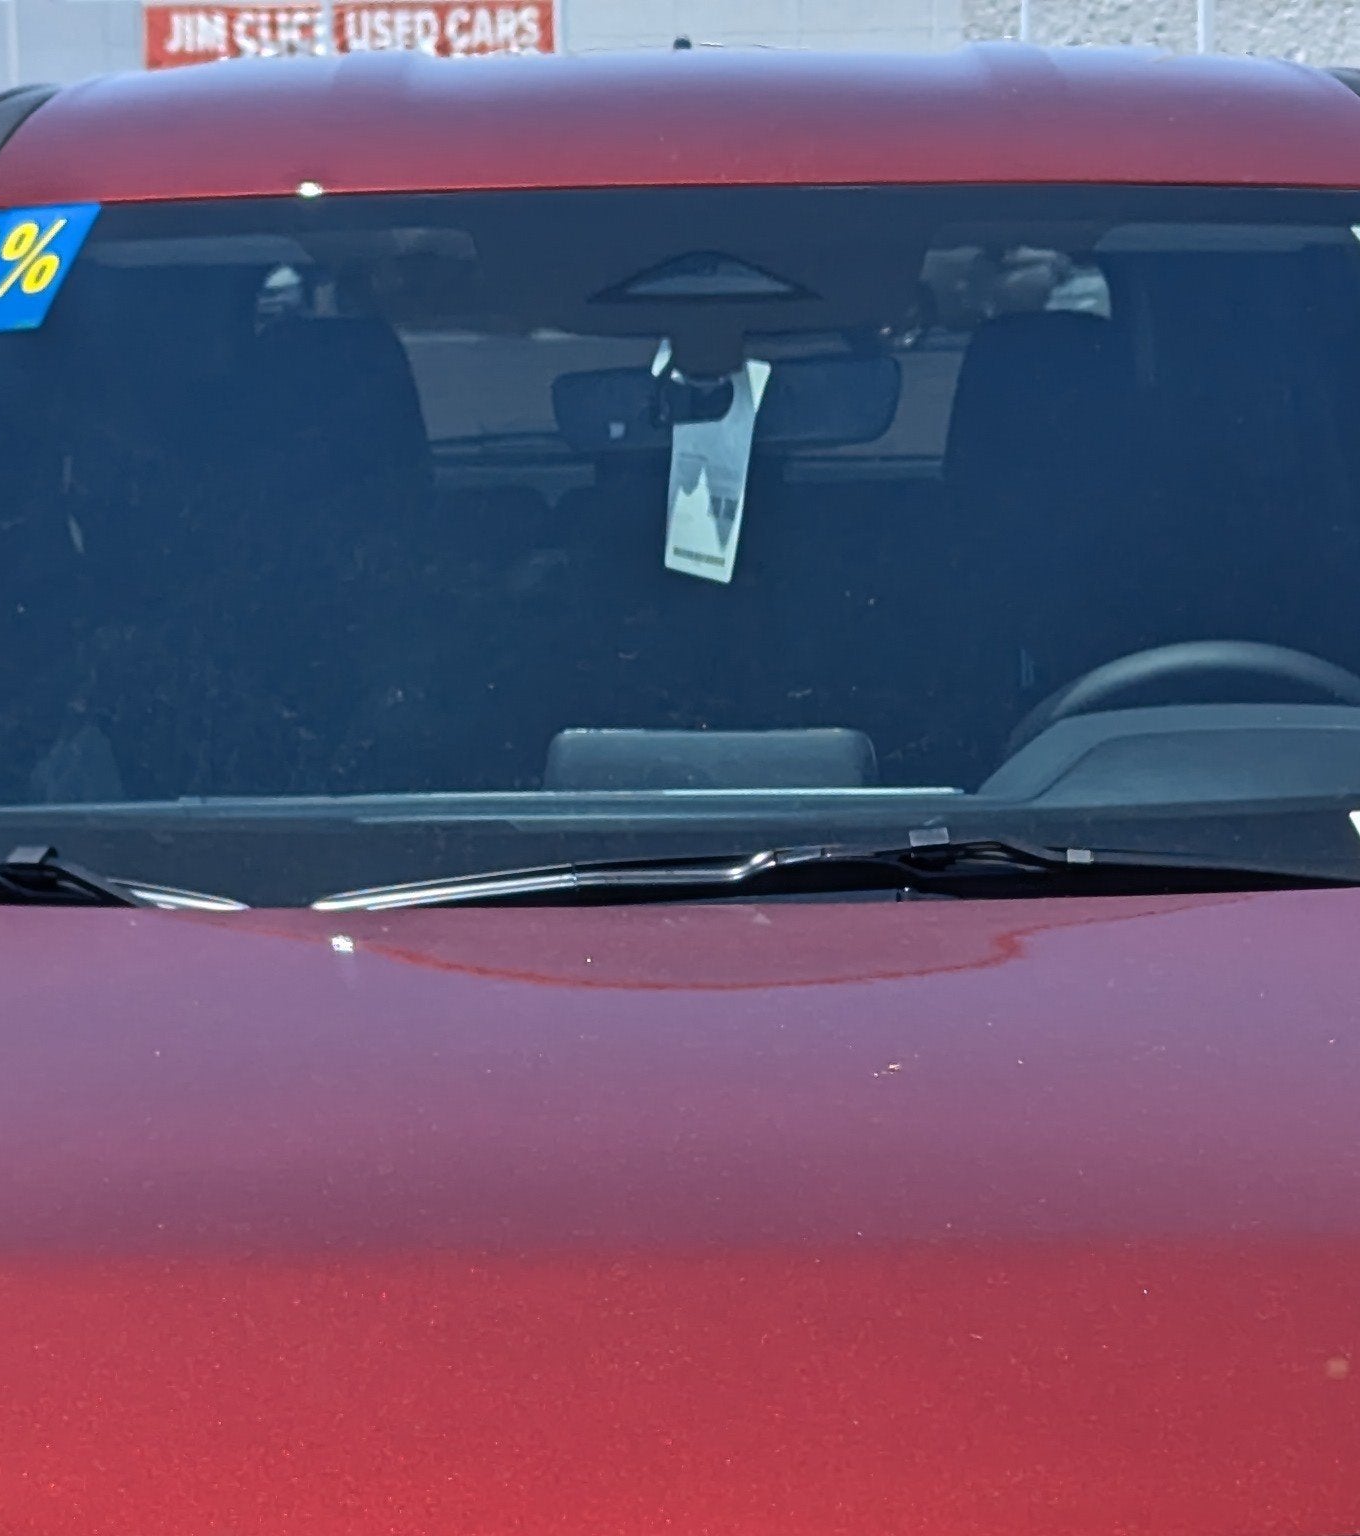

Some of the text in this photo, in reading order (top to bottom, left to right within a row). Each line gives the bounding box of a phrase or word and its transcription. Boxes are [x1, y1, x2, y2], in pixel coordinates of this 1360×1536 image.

[166, 11, 226, 54] JIM
[344, 11, 441, 55] USED
[444, 7, 540, 56] CARS
